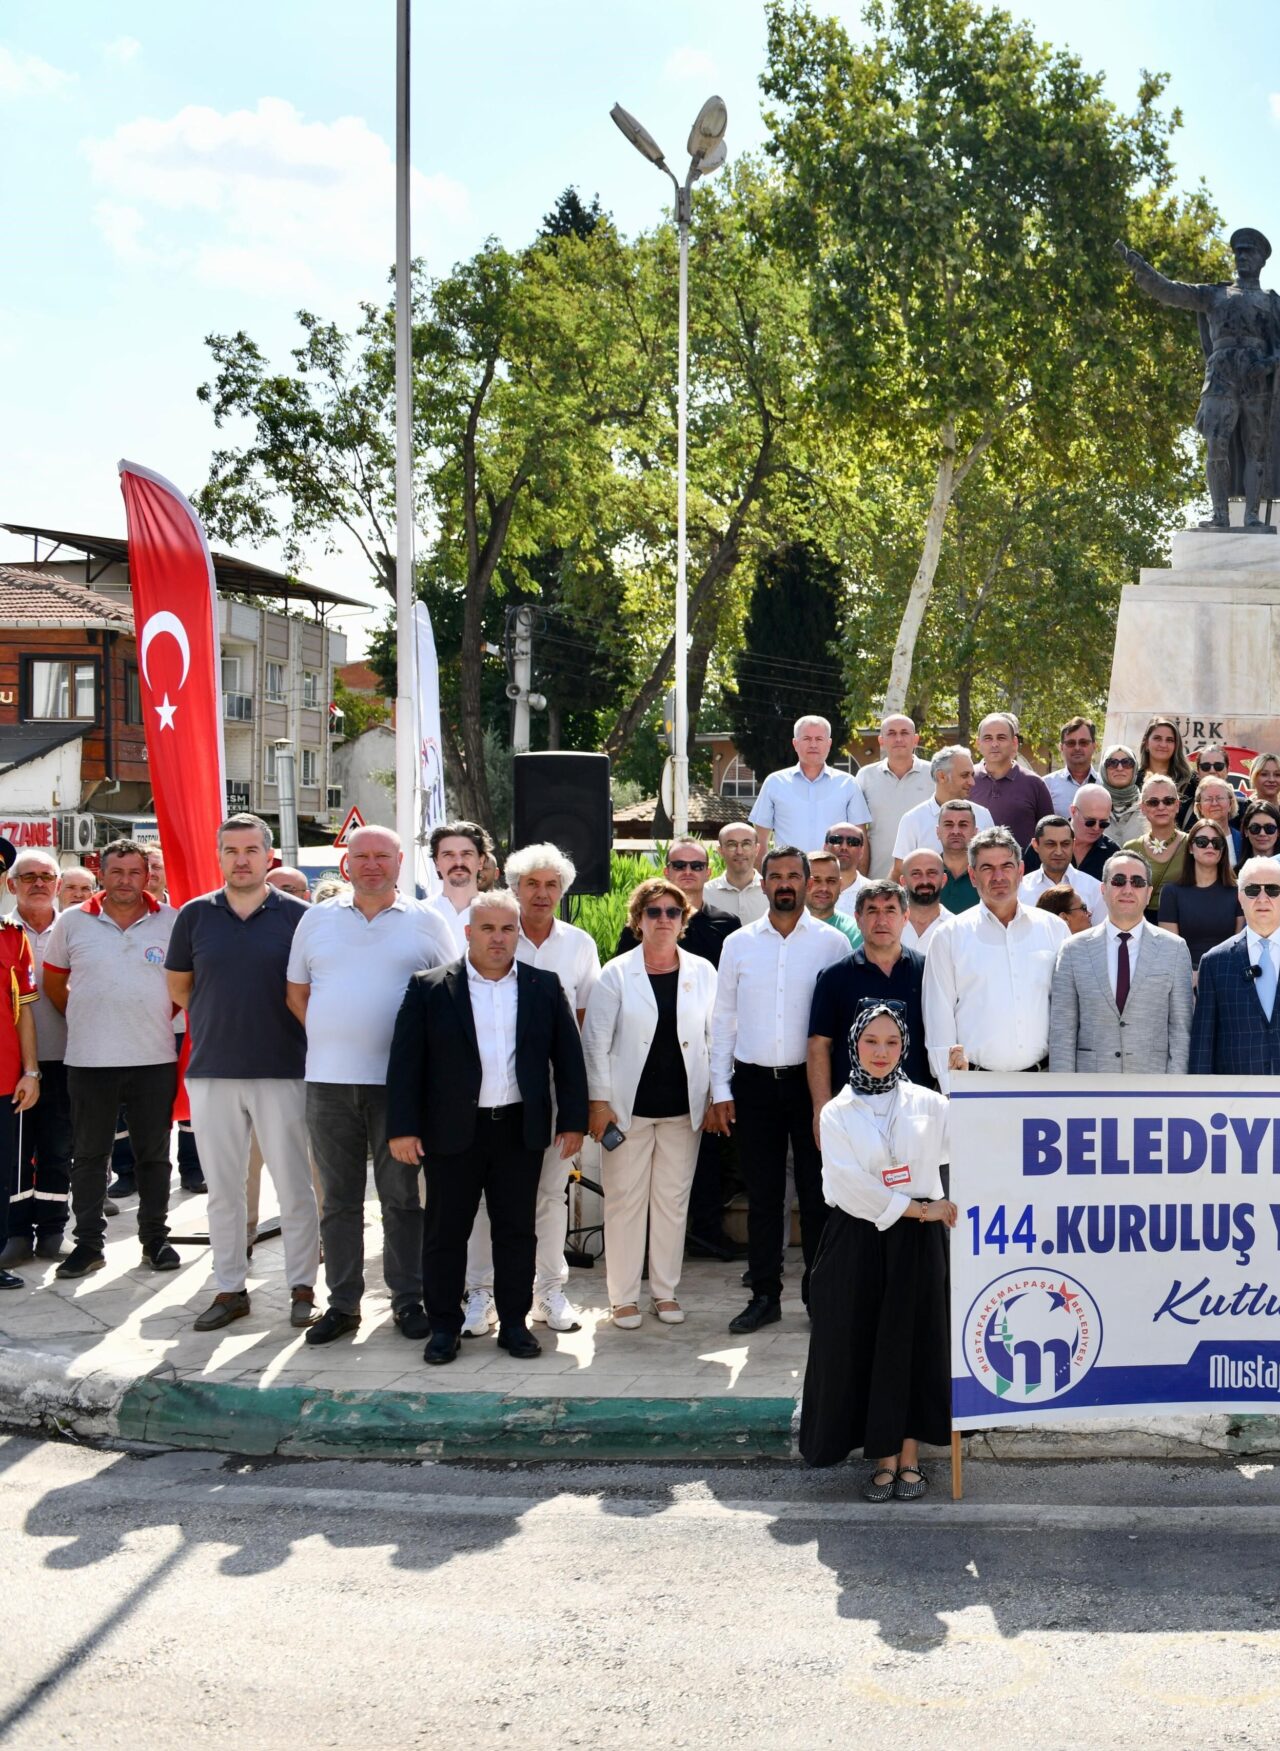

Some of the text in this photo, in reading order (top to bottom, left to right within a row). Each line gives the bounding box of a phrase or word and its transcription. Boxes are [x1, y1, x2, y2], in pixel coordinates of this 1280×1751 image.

[0, 822, 51, 847] ZANE
[974, 1280, 1090, 1374] MUSTAFAKEMALPAŞA BELEDİYESİ
